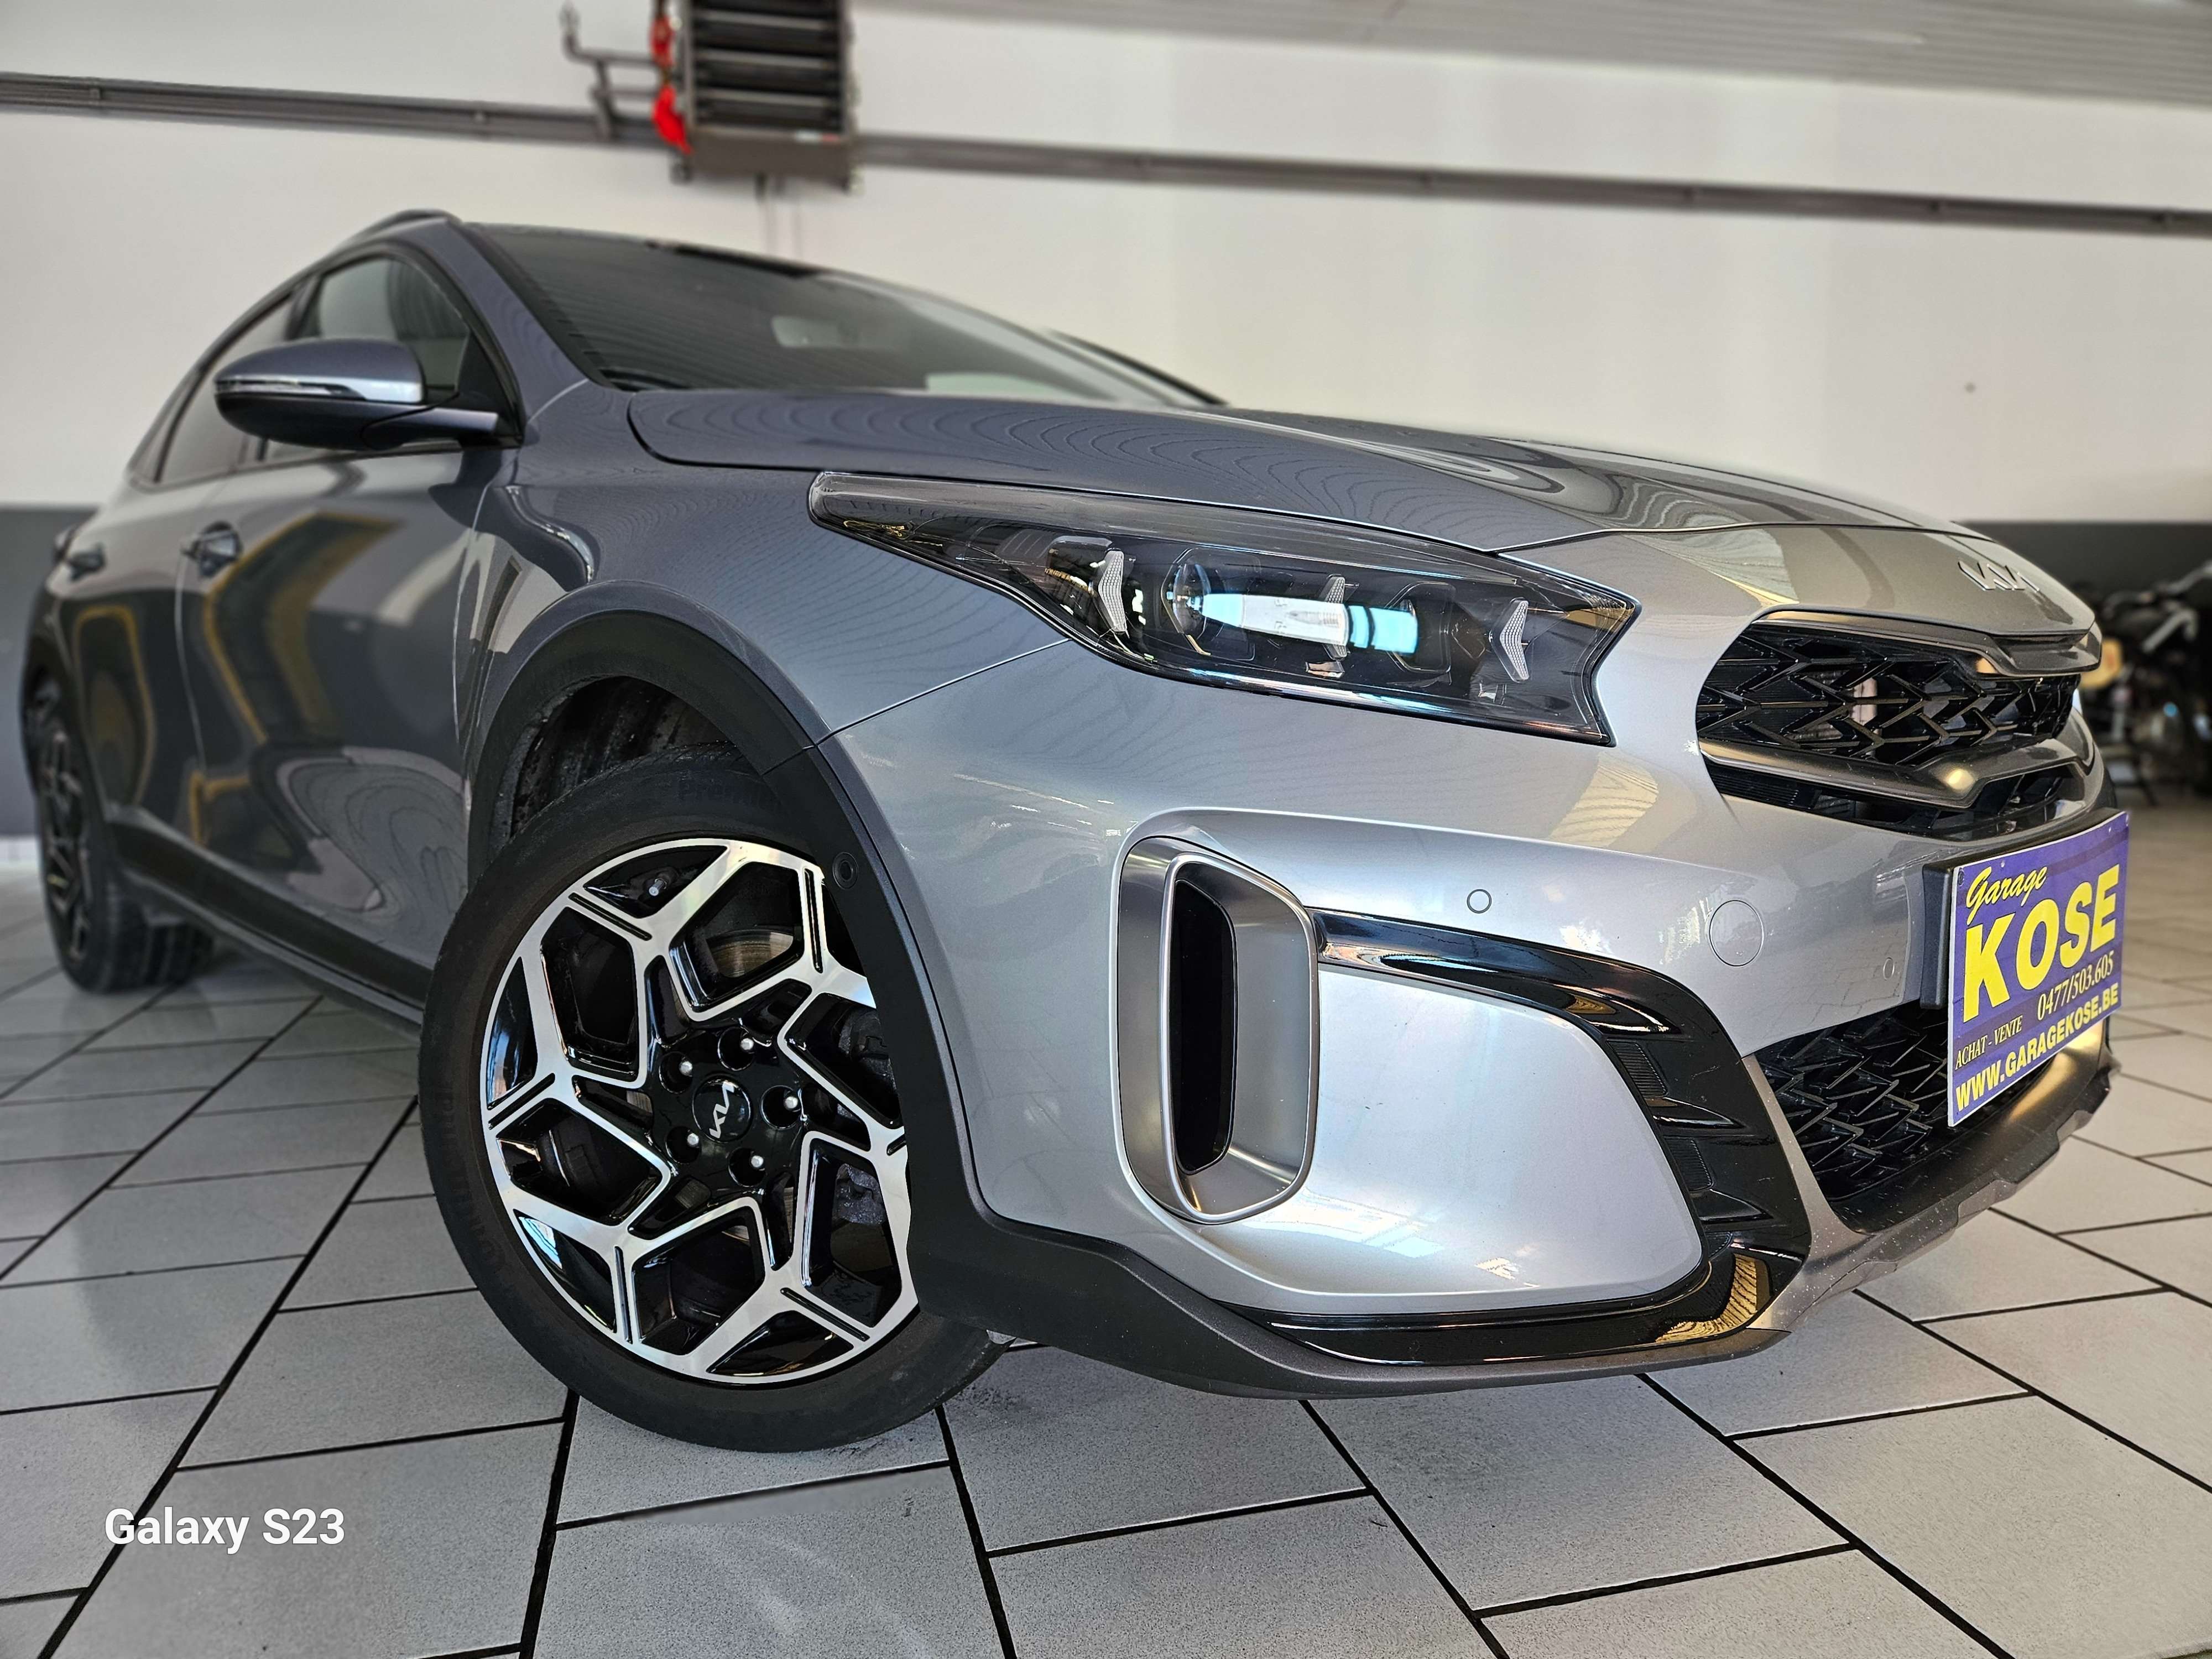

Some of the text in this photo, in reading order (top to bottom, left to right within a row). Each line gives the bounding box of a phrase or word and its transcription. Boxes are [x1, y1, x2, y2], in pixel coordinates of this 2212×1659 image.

[1966, 867, 2047, 925] Garage
[1964, 864, 2119, 1022] KOSE
[2037, 951, 2114, 1020] 0477/503.605
[1956, 1036, 1987, 1070] ACHAT
[1994, 1016, 2022, 1045] VENTE
[1956, 983, 2118, 1111] WWW.GARAGEKOSE.BE
